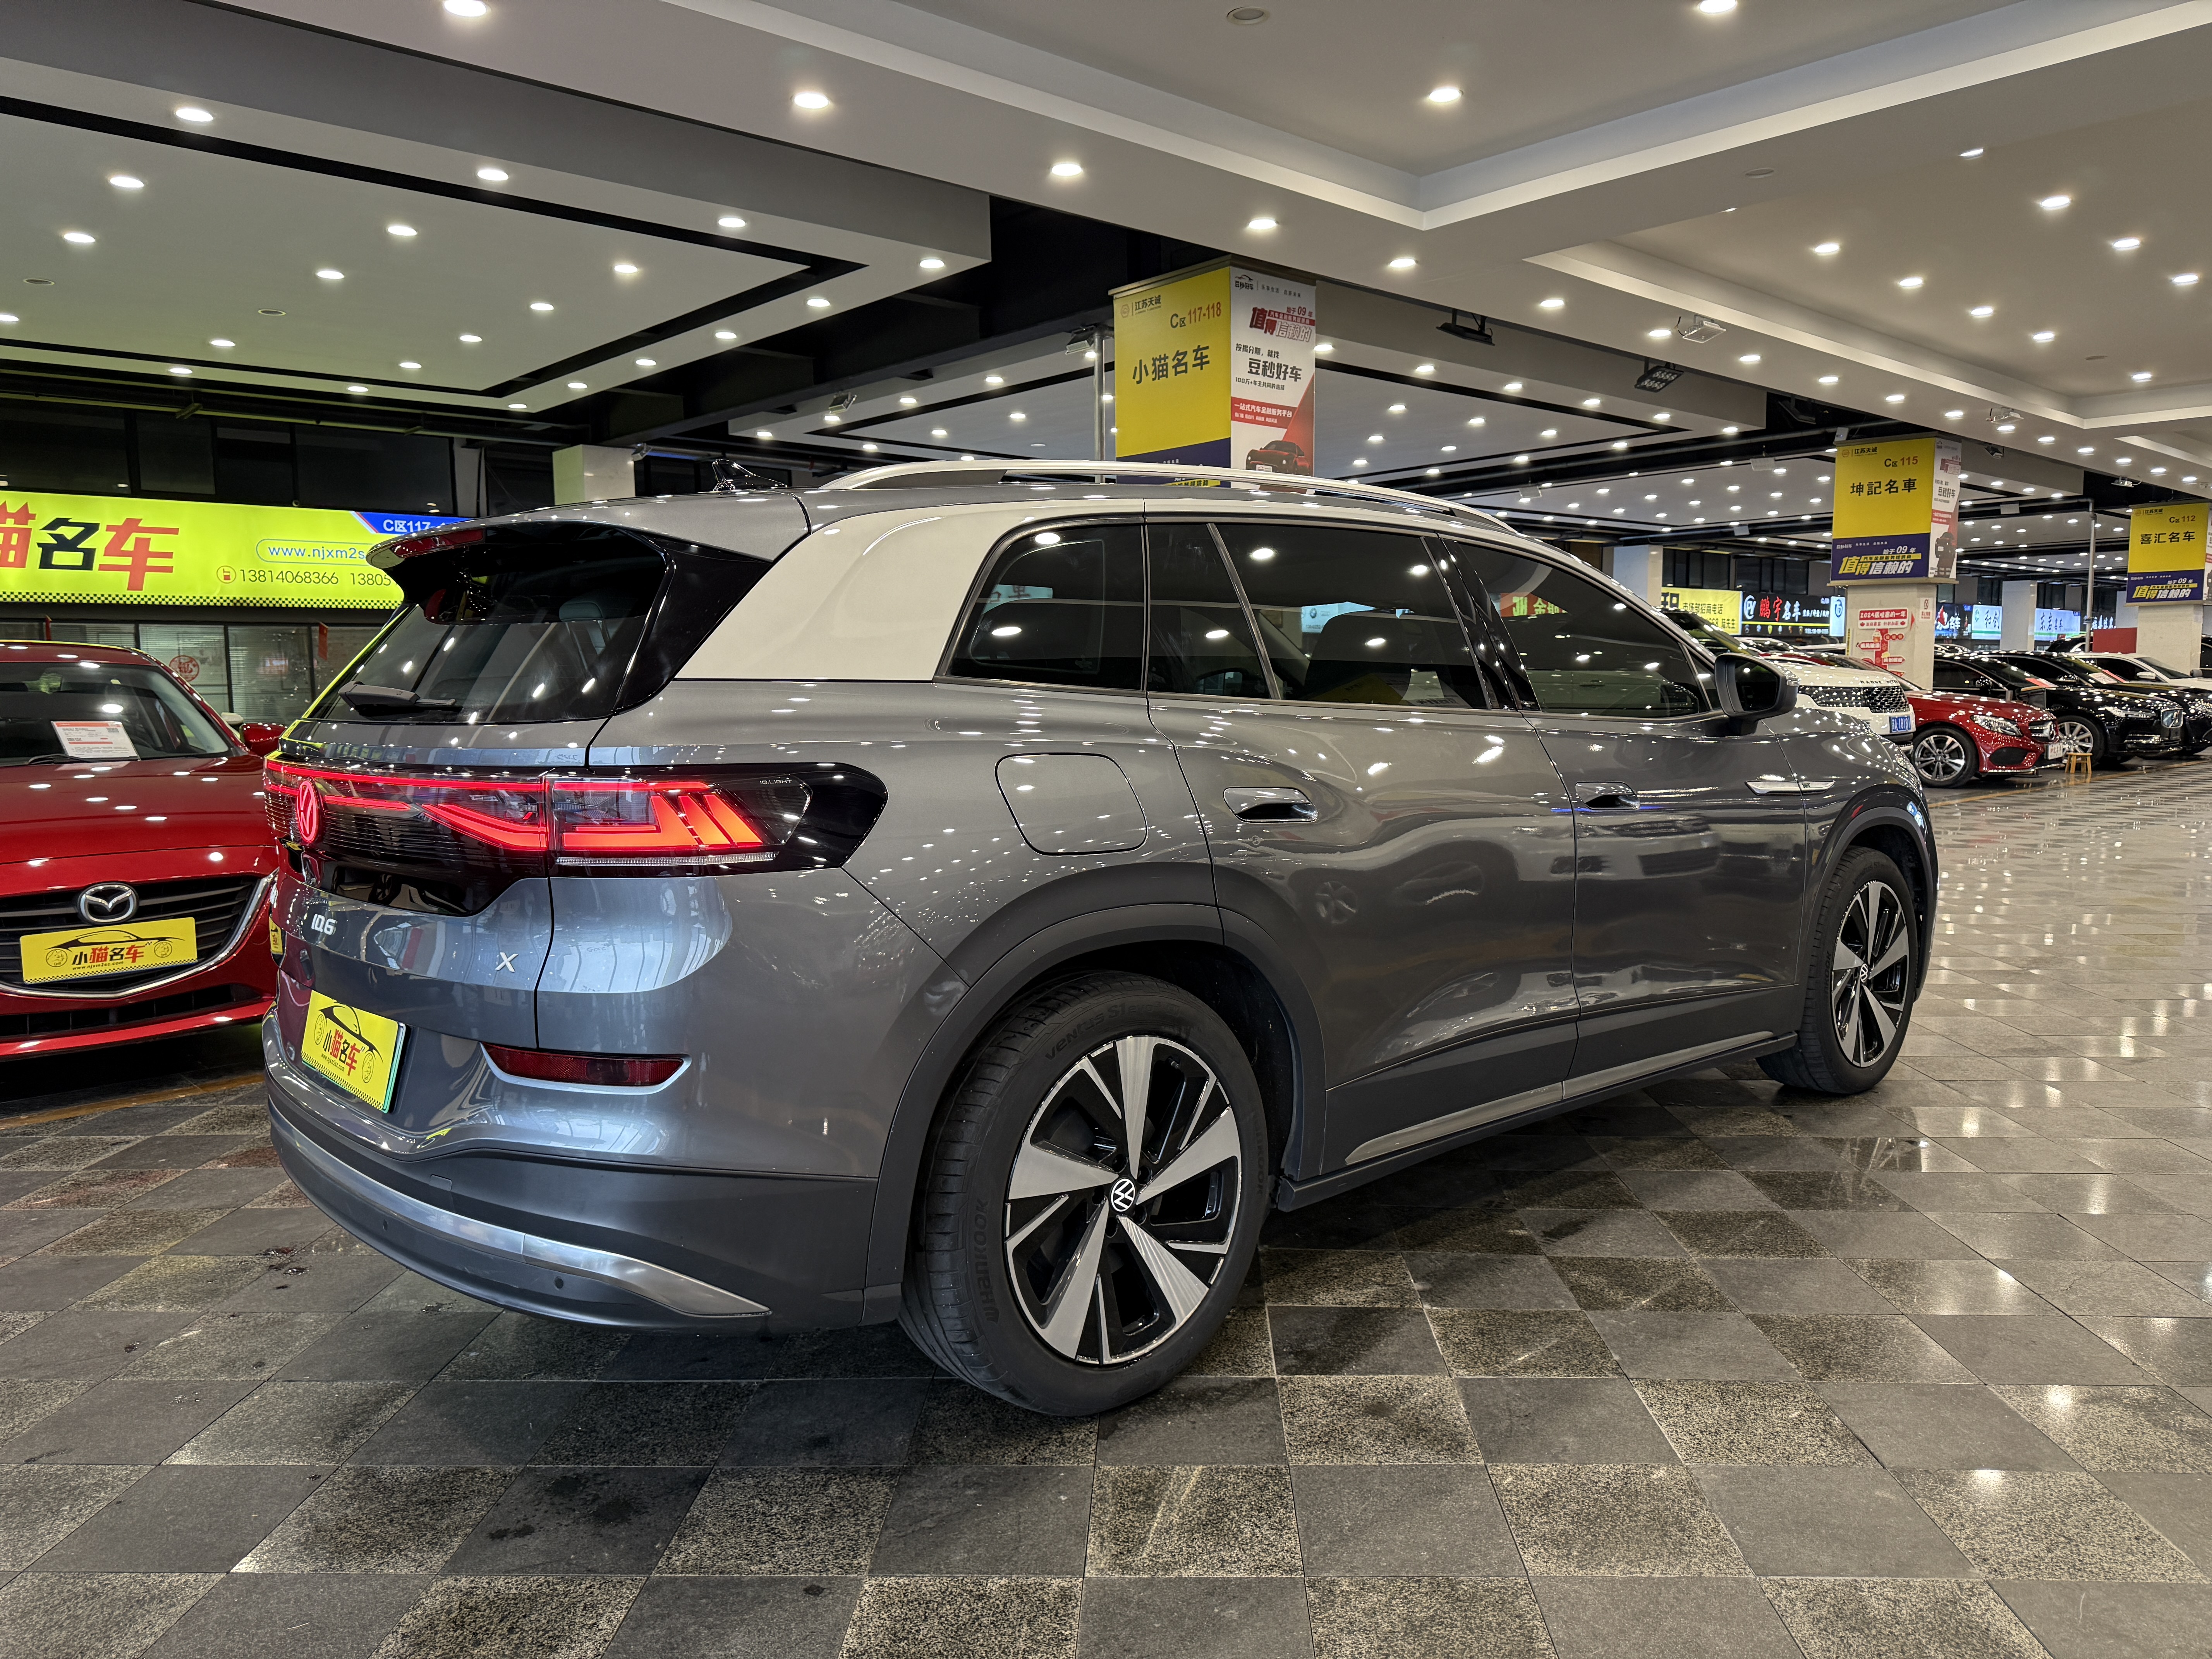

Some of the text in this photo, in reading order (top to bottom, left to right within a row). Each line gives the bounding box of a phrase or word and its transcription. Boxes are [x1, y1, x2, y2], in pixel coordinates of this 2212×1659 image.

[1135, 295, 1161, 311] 江苏天诚
[1249, 307, 1312, 342] 值得信赖的
[1132, 345, 1210, 384] 小猫名车
[1248, 358, 1302, 382] 豆秒好车
[1850, 478, 1917, 496] 坤記名車
[2140, 531, 2195, 544] 喜汇名车
[1839, 556, 1914, 575] 值得信赖的
[240, 569, 339, 584] 13814068366
[2132, 585, 2192, 599] 值得信赖的
[72, 944, 146, 966] 小猫名车
[495, 952, 518, 972] X
[72, 961, 124, 970] www.njxm2sc.com
[323, 1029, 361, 1076] 小猫名车
